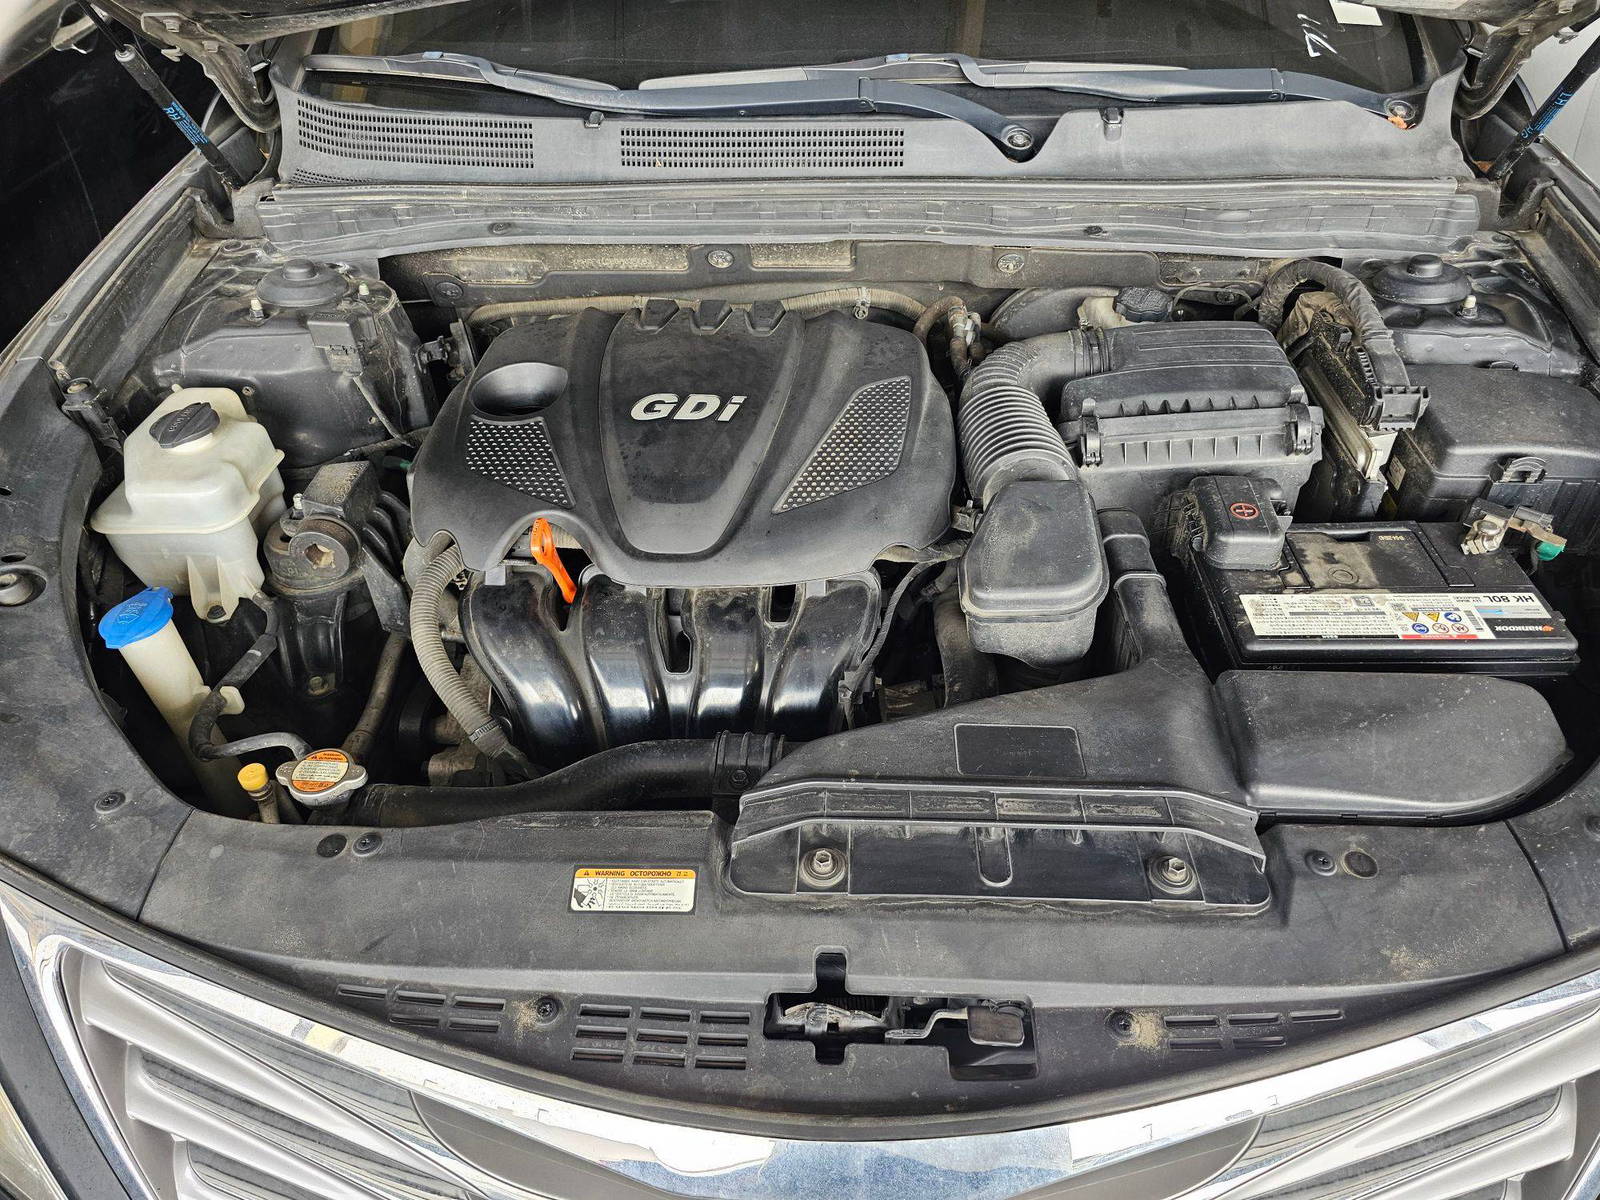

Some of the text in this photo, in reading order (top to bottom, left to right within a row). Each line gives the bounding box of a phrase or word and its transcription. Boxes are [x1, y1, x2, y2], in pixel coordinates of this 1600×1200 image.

[162, 106, 181, 120] RH
[630, 393, 747, 422] GDi
[1483, 595, 1511, 603] 80L
[1513, 595, 1535, 603] HK
